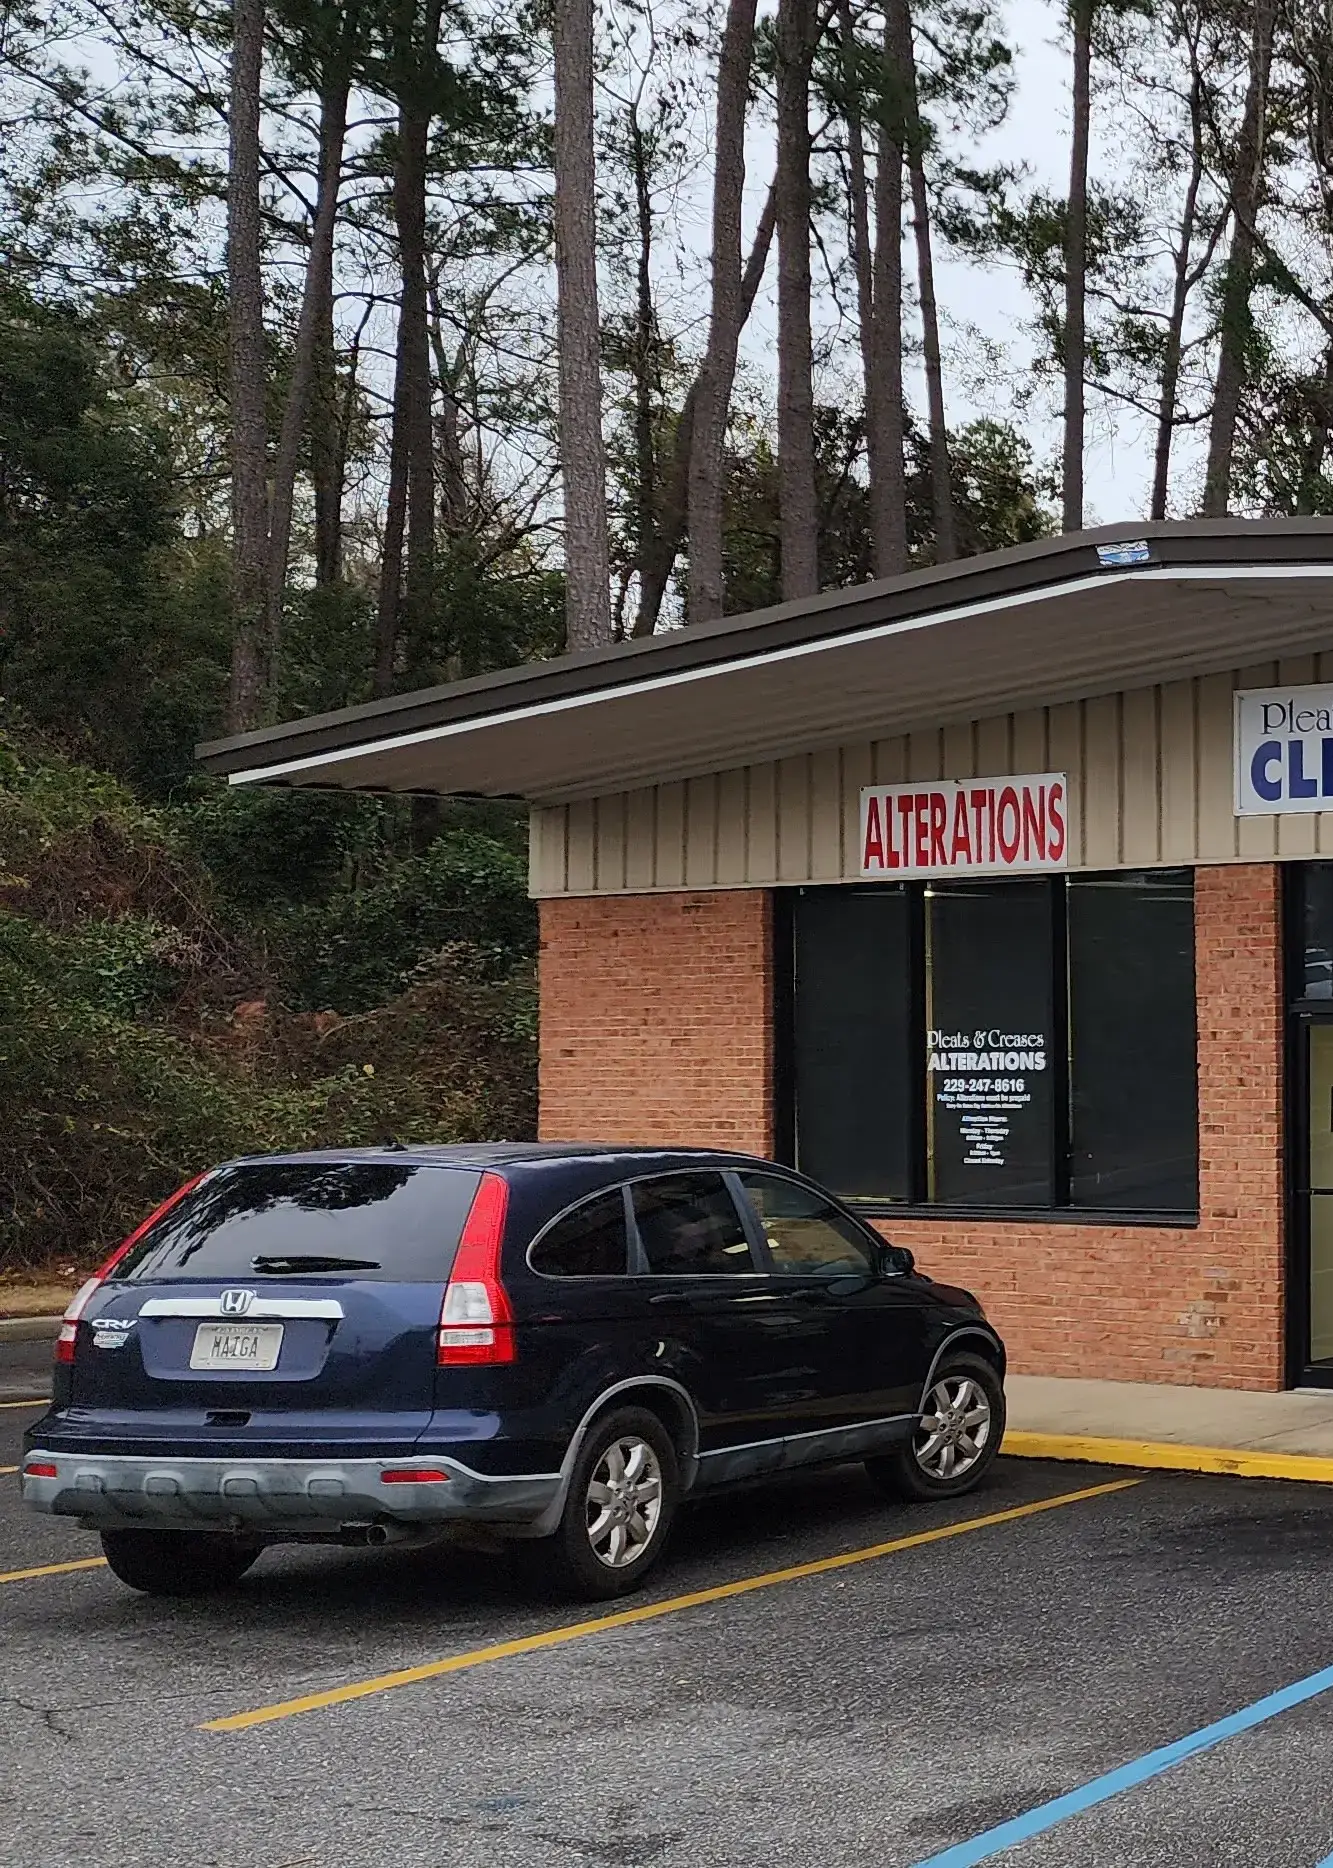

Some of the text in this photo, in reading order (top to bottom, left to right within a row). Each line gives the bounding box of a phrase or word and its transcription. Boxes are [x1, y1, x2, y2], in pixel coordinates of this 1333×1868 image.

[864, 783, 1065, 870] ALTERATIONS
[927, 1029, 1045, 1049] Pleats & Creases
[927, 1052, 1047, 1071] ALTERATIONS
[943, 1078, 1025, 1093] 229-247-8616
